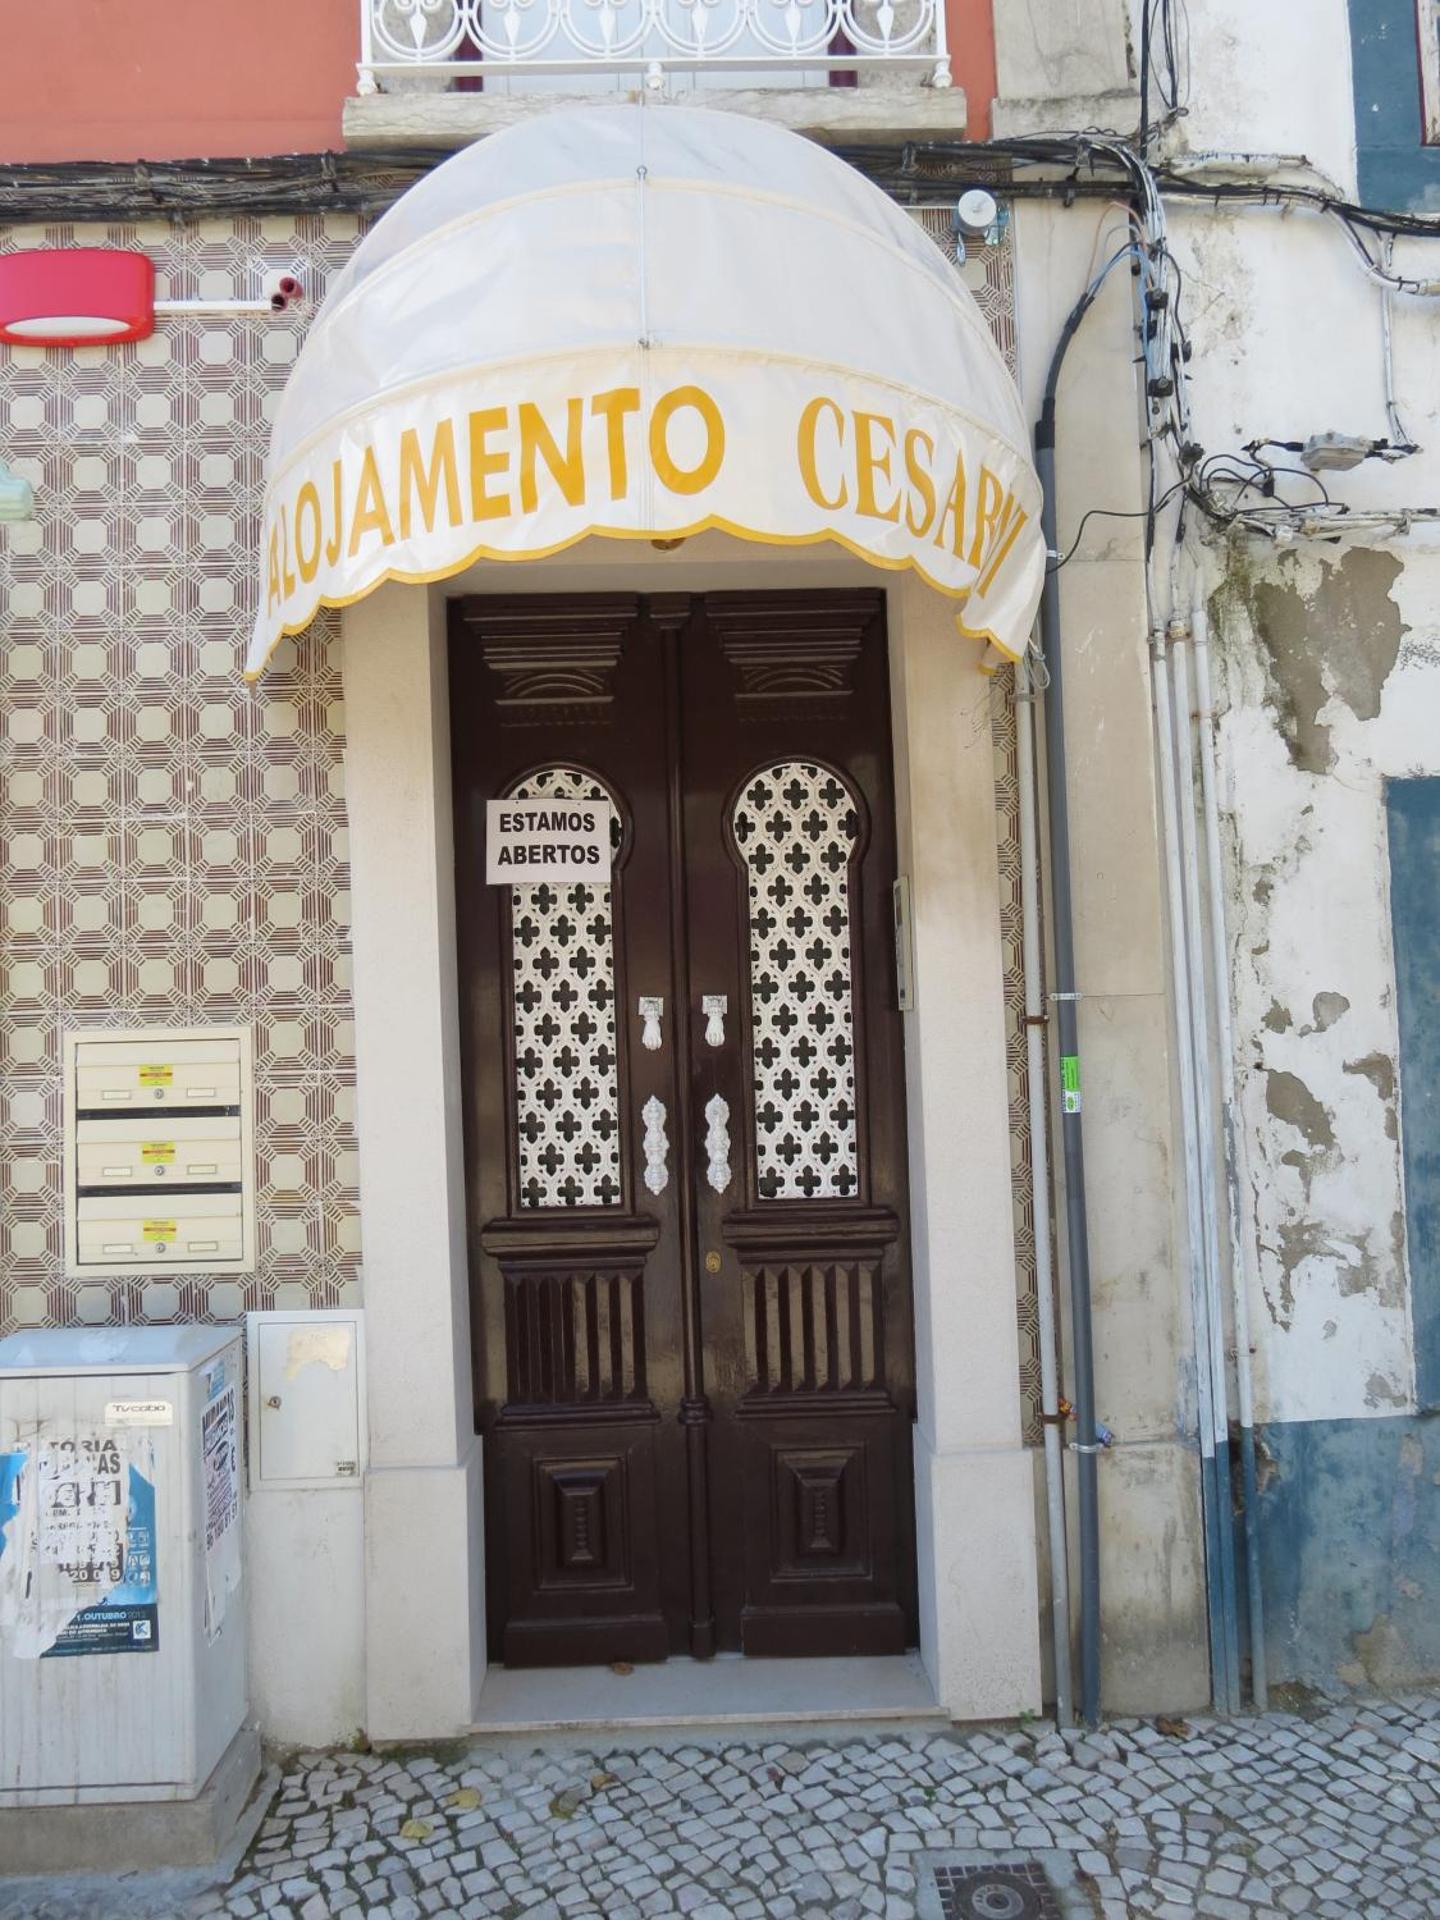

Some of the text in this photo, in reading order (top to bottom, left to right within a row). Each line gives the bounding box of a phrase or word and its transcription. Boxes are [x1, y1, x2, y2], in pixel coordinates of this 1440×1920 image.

[267, 385, 726, 619] ALOJAMENTO
[500, 811, 595, 833] ESTAMOS
[498, 844, 600, 866] ABERTOS
